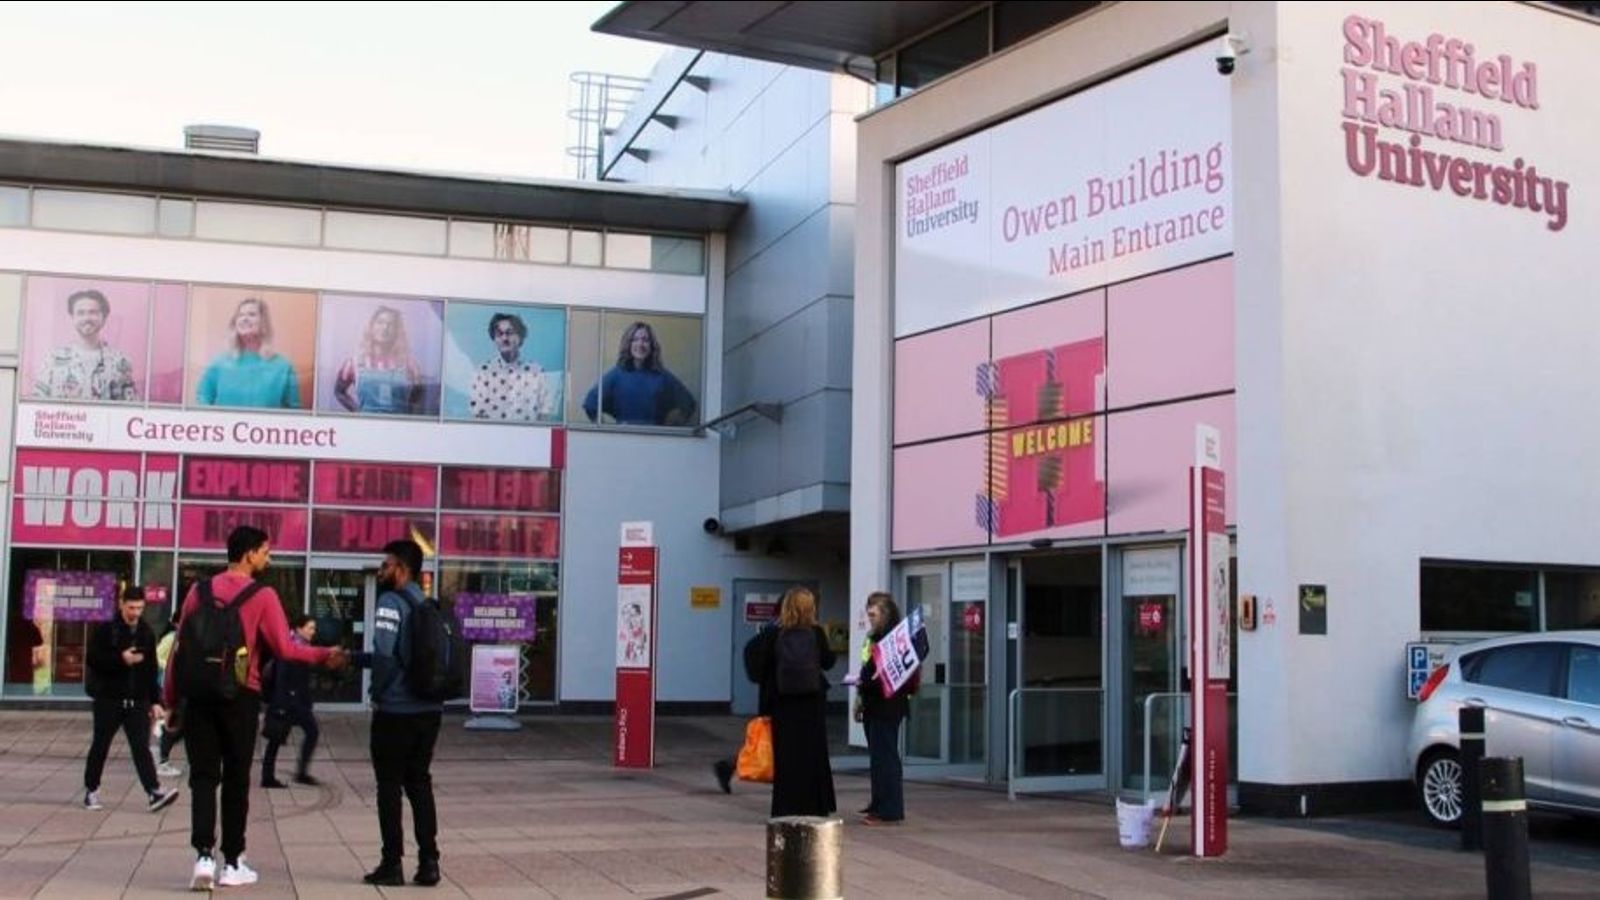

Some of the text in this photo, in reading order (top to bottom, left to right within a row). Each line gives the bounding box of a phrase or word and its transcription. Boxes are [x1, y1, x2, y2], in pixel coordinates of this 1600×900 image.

[1343, 14, 1539, 110] Sheffield
[1341, 67, 1503, 151] Hallam
[907, 155, 969, 197] Sheffield
[1003, 143, 1224, 243] Owen Building
[1341, 121, 1569, 231] University
[907, 186, 956, 218] Hallam
[907, 199, 979, 238] University
[1049, 205, 1224, 275] Main Entrance
[126, 417, 337, 448] Careers Connect
[1012, 420, 1092, 458] WELCOME
[22, 466, 177, 530] WORK
[189, 460, 300, 498] EXPLORE
[337, 466, 412, 502] LEARN
[460, 470, 547, 507] TALENT
